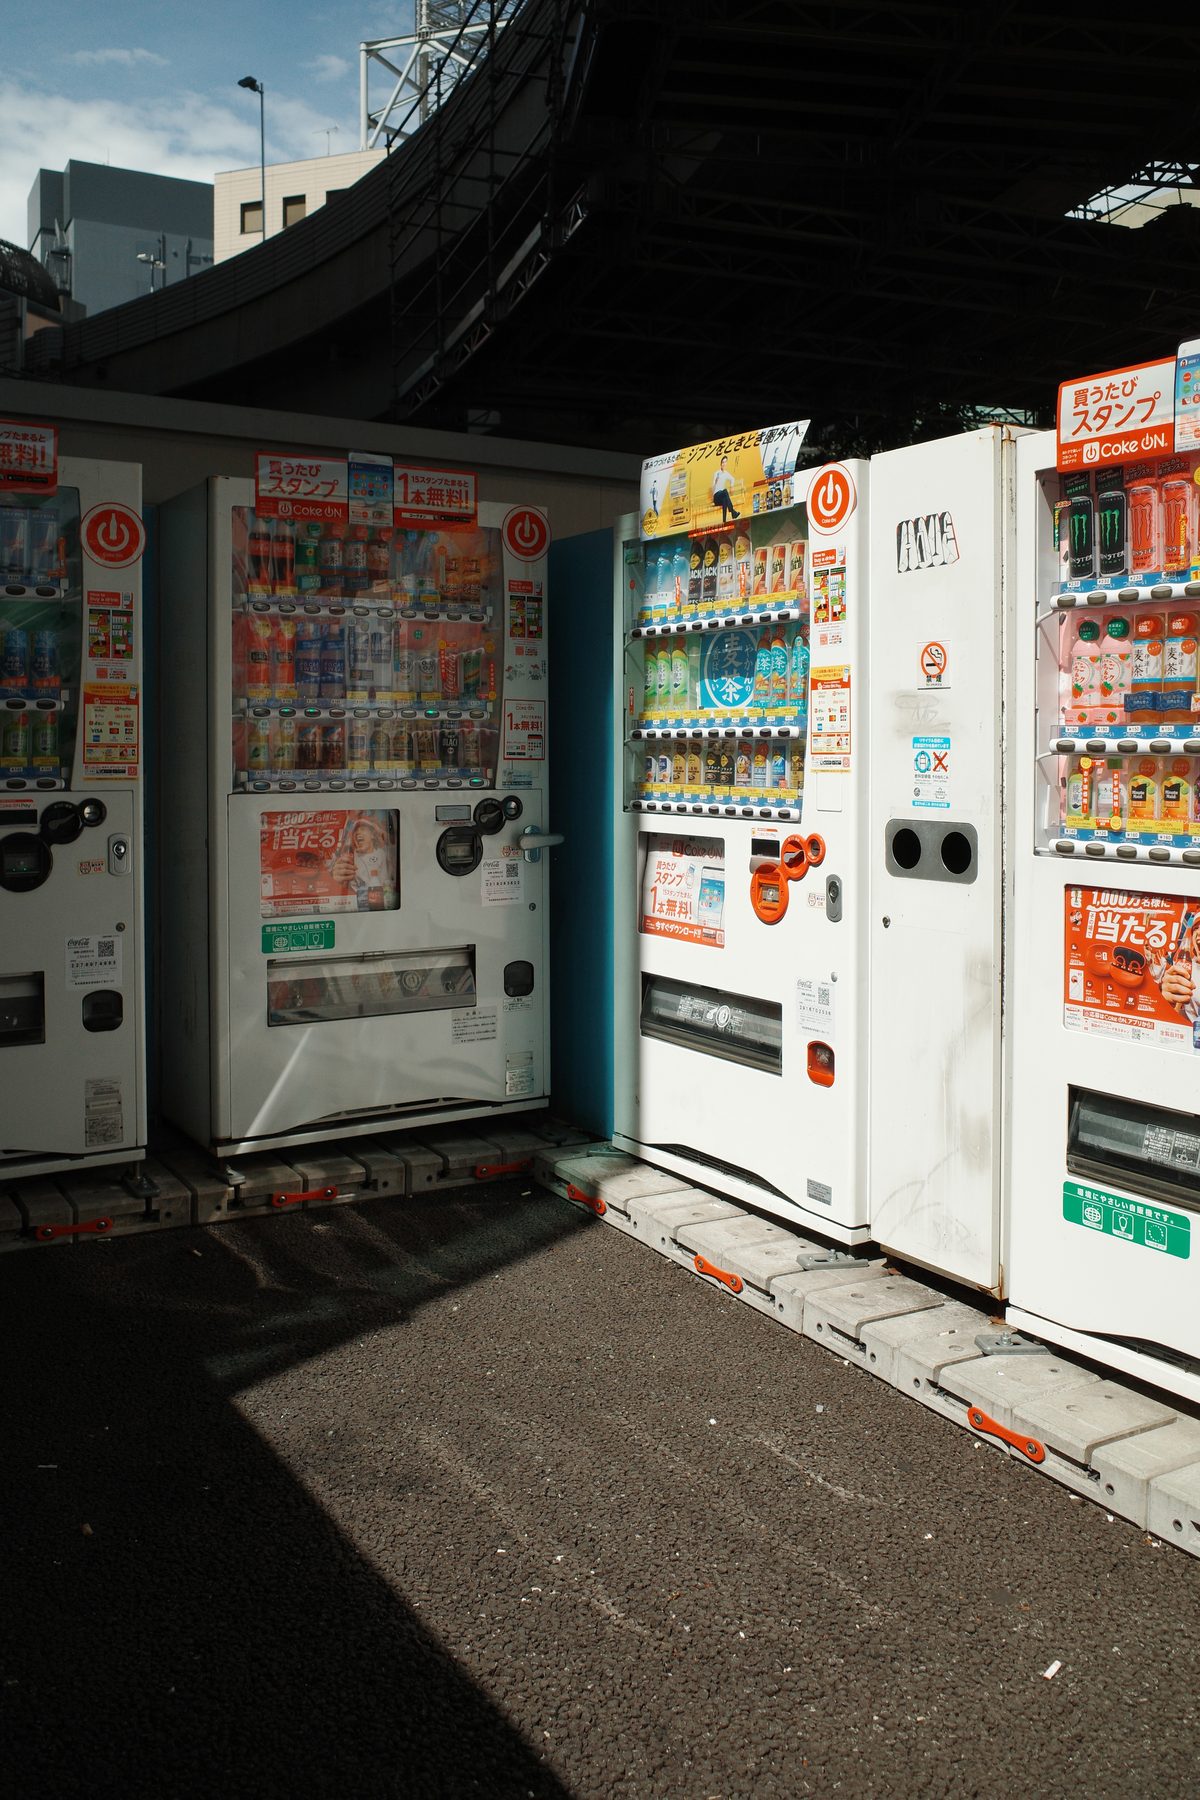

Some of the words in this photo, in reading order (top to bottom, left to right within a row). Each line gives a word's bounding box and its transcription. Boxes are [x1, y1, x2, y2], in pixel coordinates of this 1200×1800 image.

[1073, 376, 1139, 409] 買うたび
[1072, 391, 1161, 436] スタンプ
[1101, 440, 1138, 457] Coke
[1141, 433, 1165, 450] ON
[269, 460, 321, 477] 買うたび
[268, 476, 339, 498] スタンプ
[411, 475, 469, 488] 15スタンプたまると
[293, 504, 323, 517] Coke
[324, 506, 342, 518] ON
[720, 633, 744, 704] 麦茶
[1134, 649, 1144, 677] 麦茶
[1167, 647, 1178, 676] 麦茶
[507, 713, 542, 731] 1本無料!
[281, 828, 343, 850] 当たる!
[656, 860, 677, 871] 買うたび
[655, 872, 685, 886] スタンプ
[1092, 889, 1171, 908] 1,000万名様に
[1096, 911, 1180, 951] 当たる!
[1077, 1188, 1174, 1224] 環境にやさしい自販機です。
